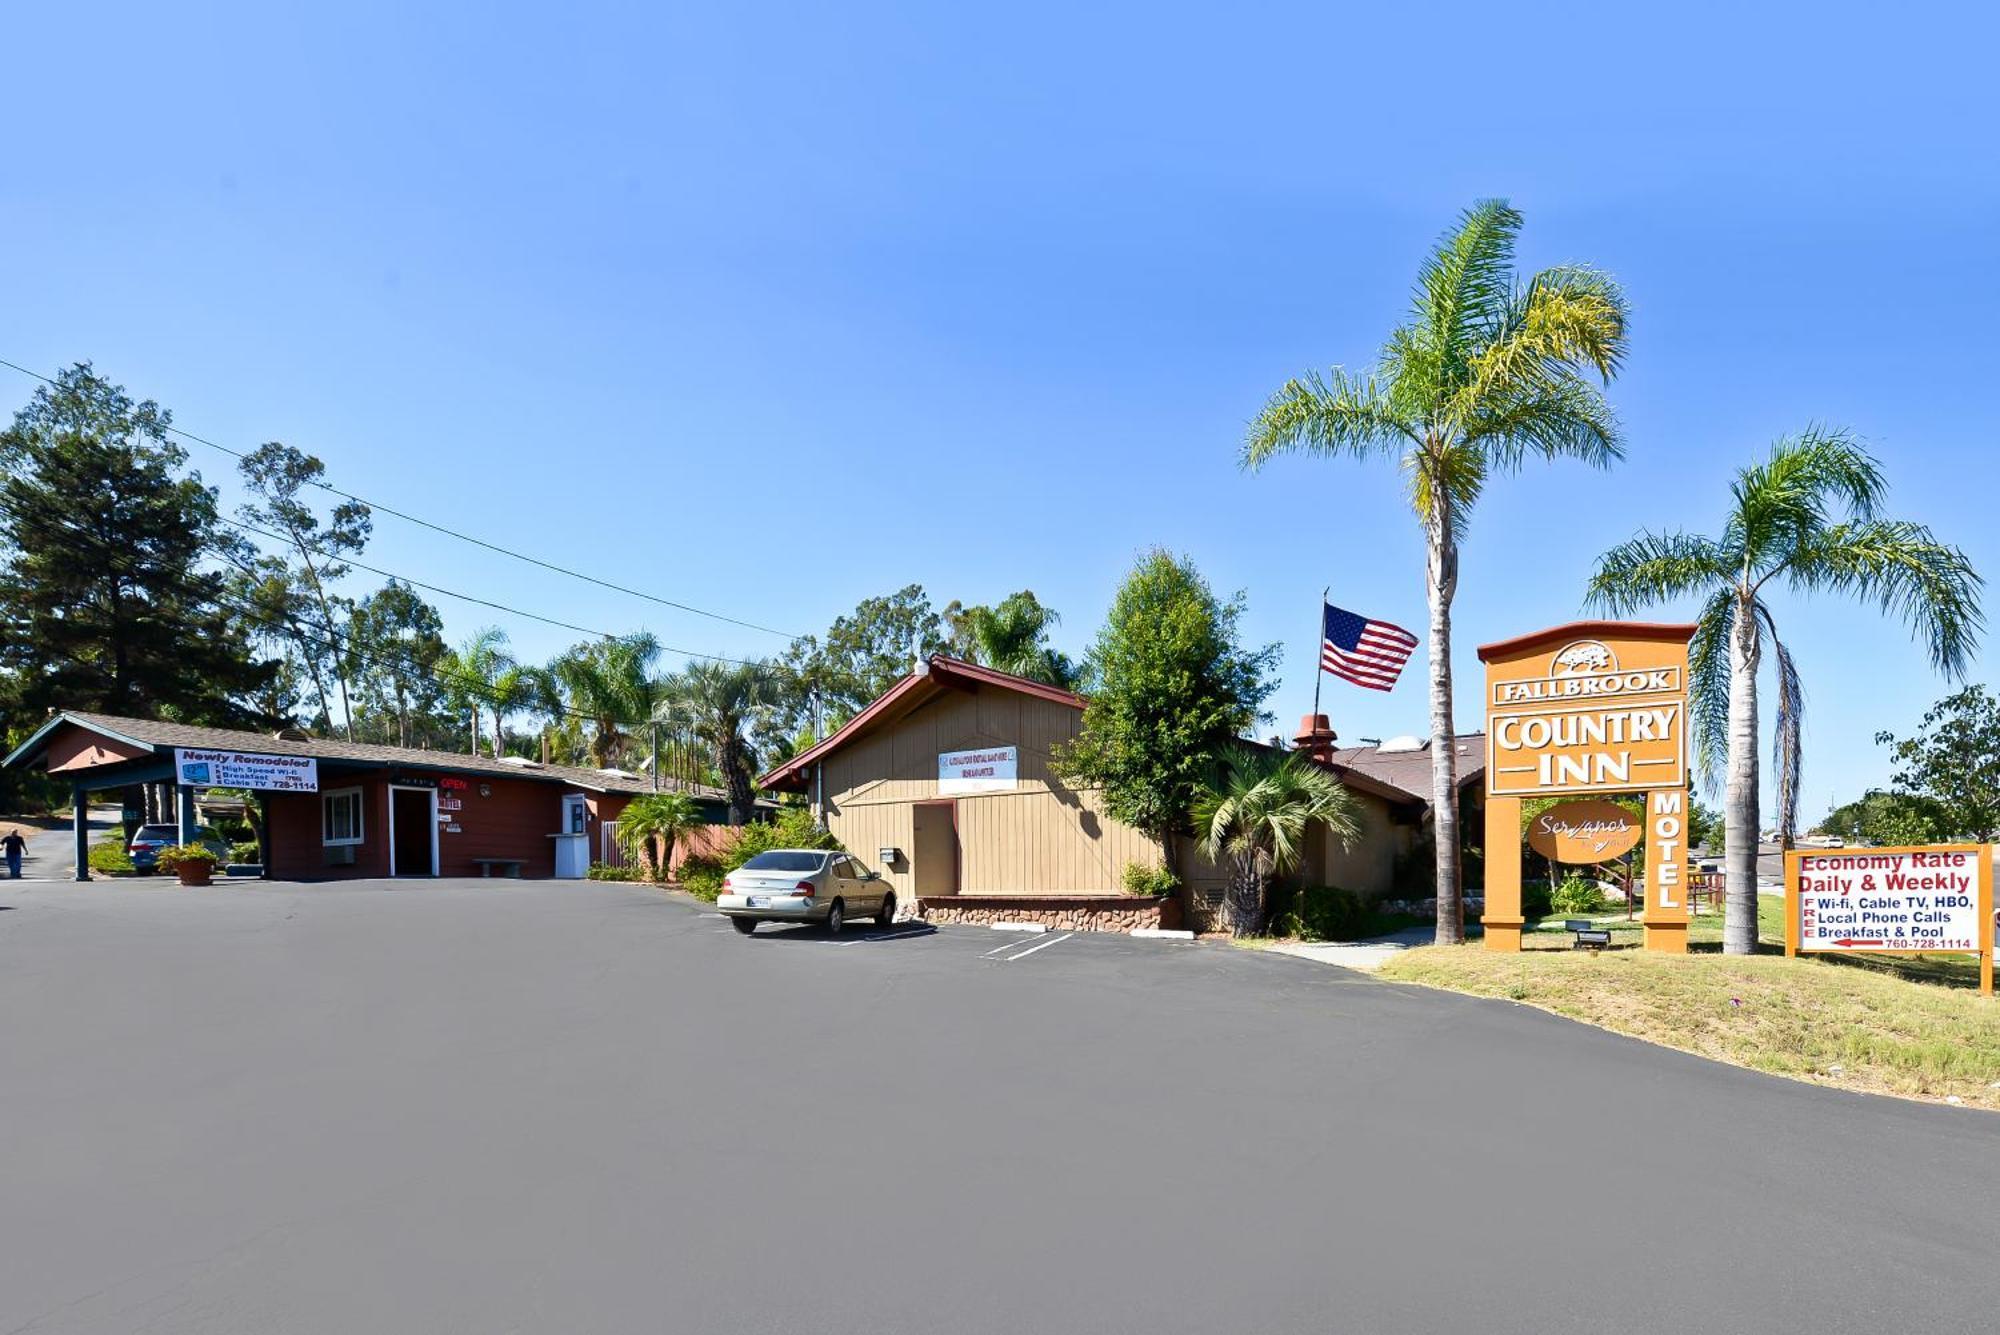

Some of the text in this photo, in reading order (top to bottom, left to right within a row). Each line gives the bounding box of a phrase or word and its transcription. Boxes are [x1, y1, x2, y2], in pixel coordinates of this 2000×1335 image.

[1503, 671, 1670, 701] FALLBROOK
[1496, 708, 1677, 750] COUNTRY
[182, 751, 310, 768] Newly Remodeled
[222, 765, 244, 773] High
[247, 766, 275, 775] Speed
[222, 772, 269, 781] Breakfast
[1538, 751, 1631, 786] INN
[223, 779, 250, 787] Cable
[272, 780, 317, 790] 728-1114
[1654, 791, 1681, 908] MOTEL
[1801, 851, 1966, 873] Economy Rate
[1798, 872, 1970, 896] Daily & Weekly
[1818, 895, 1974, 911] Wi-fi, Cable TV, HBO,
[1804, 898, 1816, 938] FREE
[1818, 911, 1951, 924] Local Phone Calls
[1818, 926, 1943, 938] Breakfast & Pool
[1885, 939, 1971, 949] 760-728-1114
